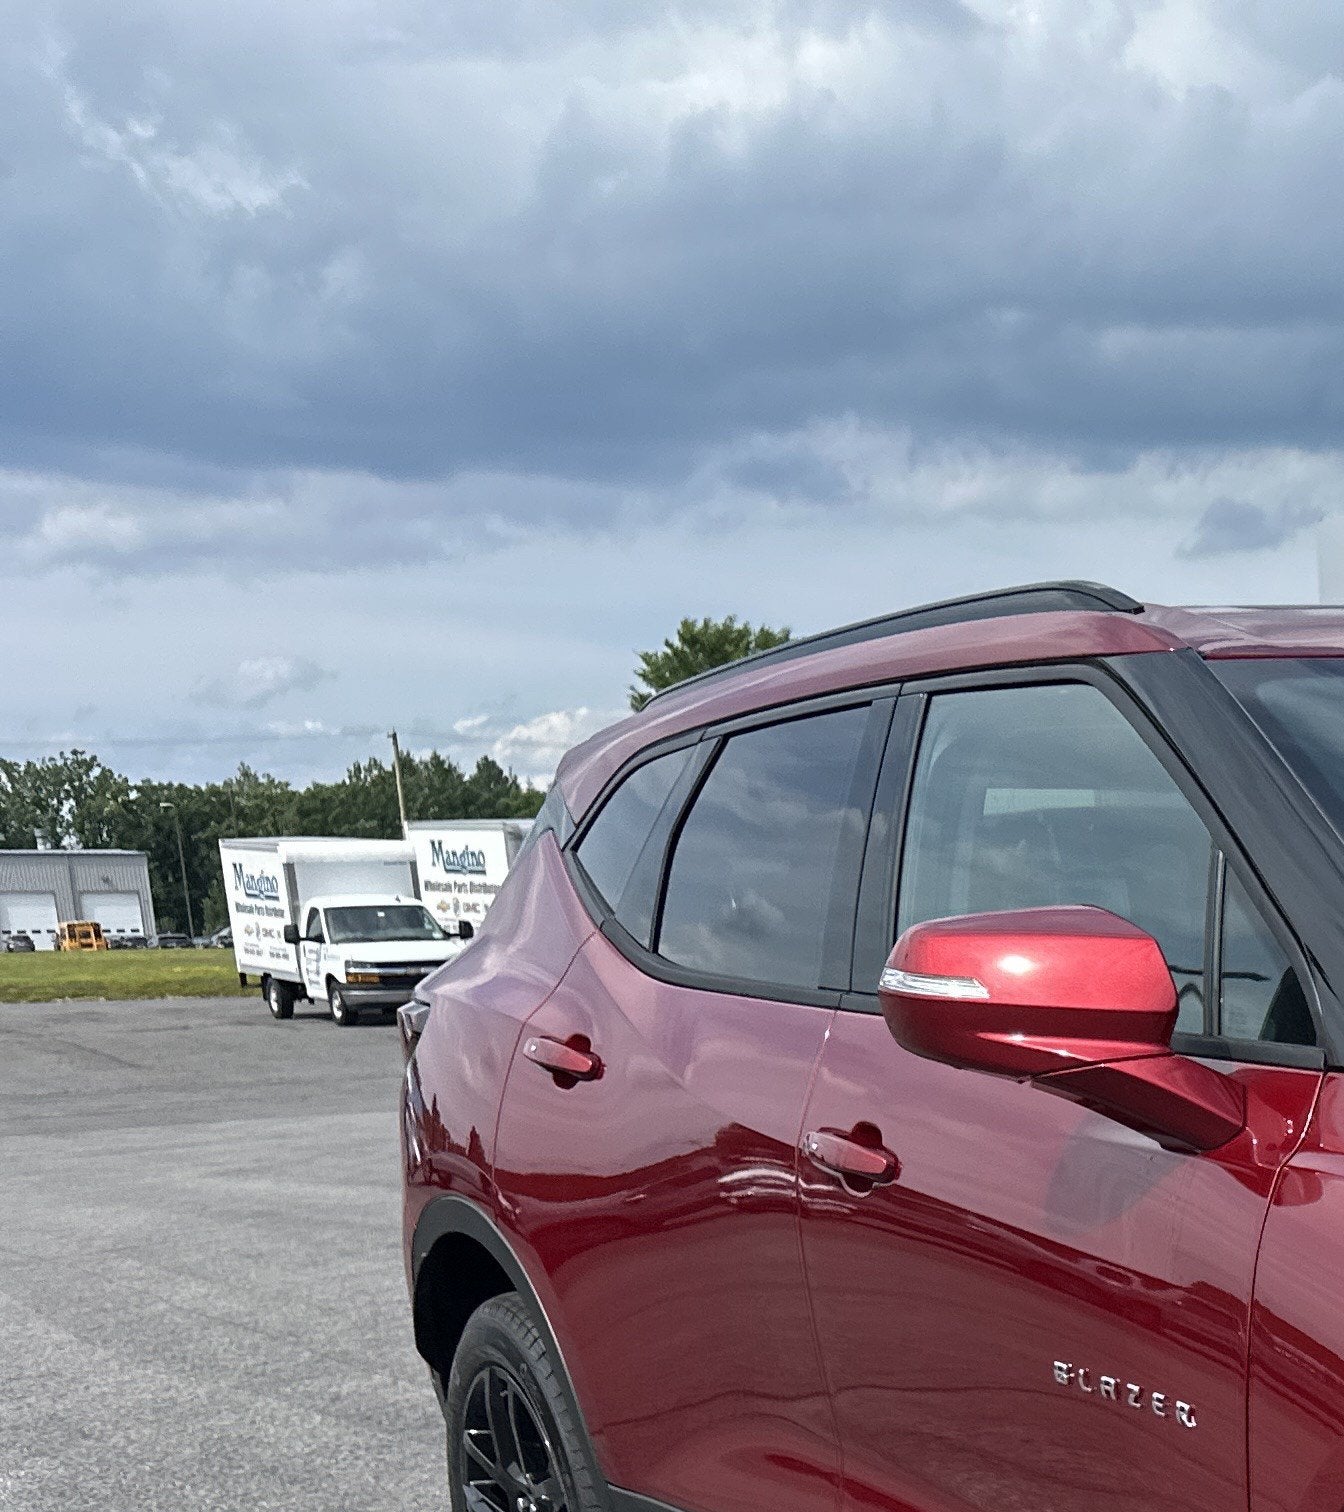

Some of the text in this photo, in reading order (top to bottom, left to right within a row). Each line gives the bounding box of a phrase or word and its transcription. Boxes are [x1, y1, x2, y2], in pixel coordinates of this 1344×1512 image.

[429, 839, 487, 876] Mangino
[232, 862, 280, 900] Mangino
[453, 881, 468, 894] Parts
[1053, 1360, 1197, 1428] BLAZER
